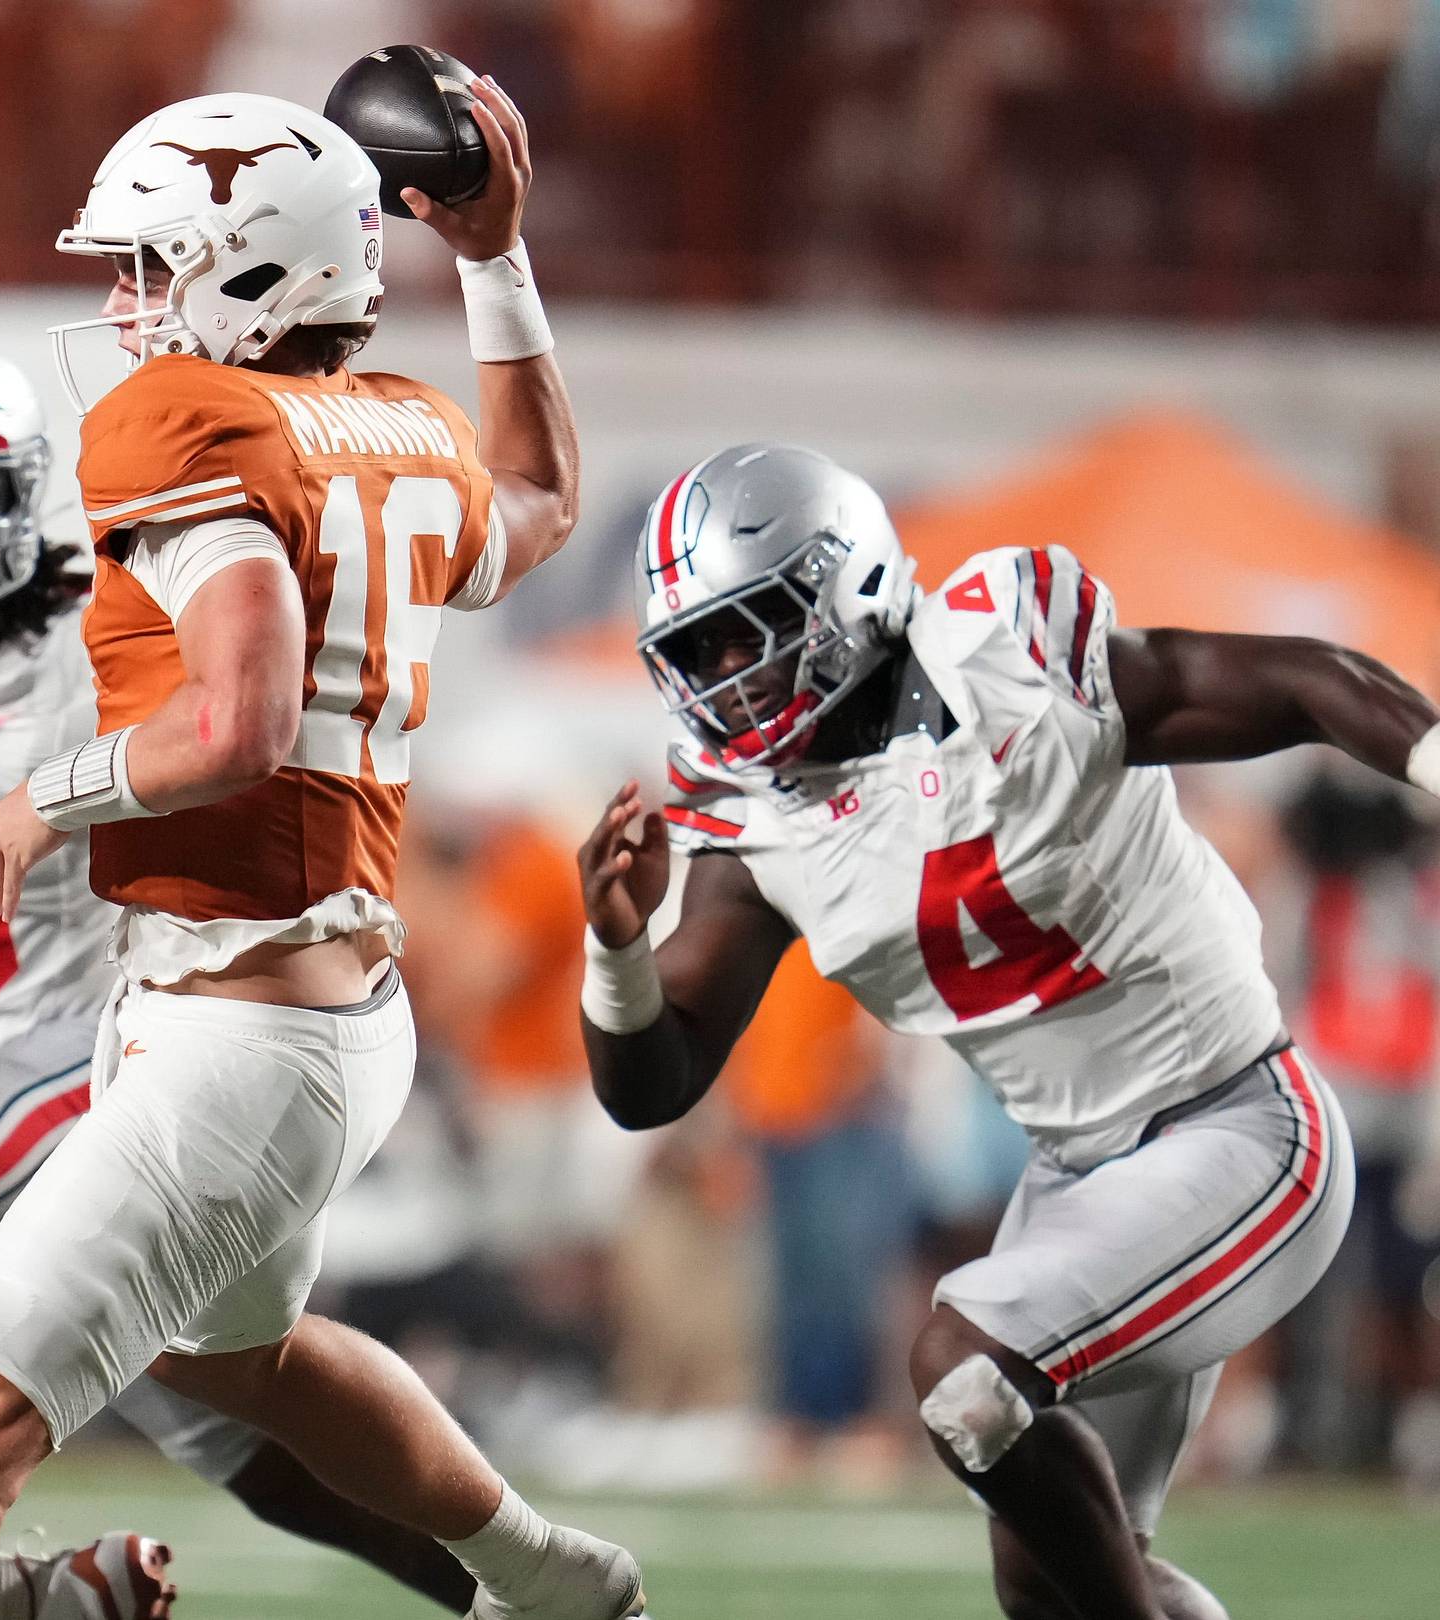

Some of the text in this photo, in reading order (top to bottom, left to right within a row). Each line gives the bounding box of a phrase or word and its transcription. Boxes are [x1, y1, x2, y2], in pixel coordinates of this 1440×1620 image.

[269, 390, 457, 459] MANNING
[280, 474, 463, 785] 16
[916, 833, 1110, 1023] 4
